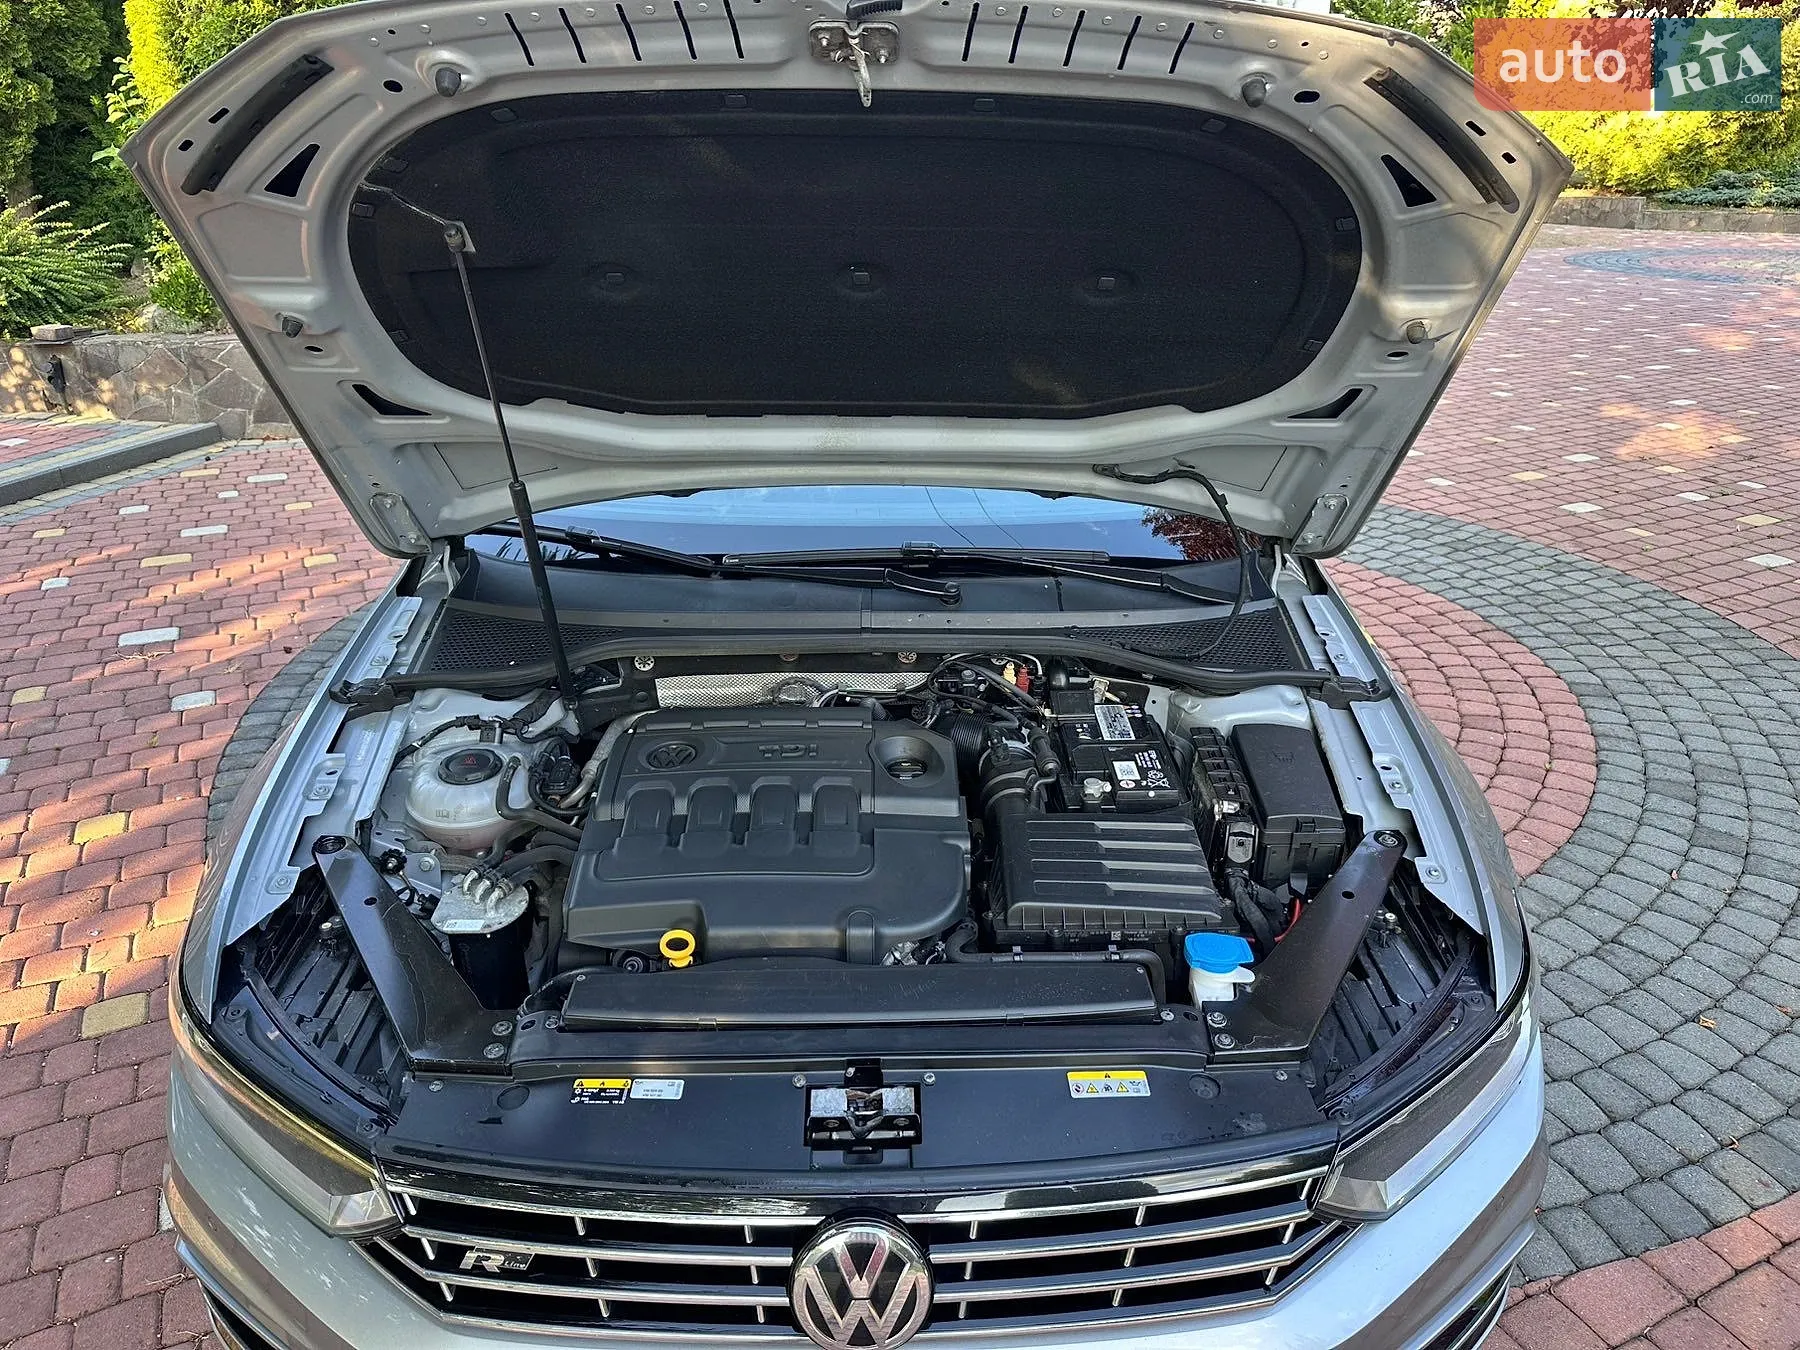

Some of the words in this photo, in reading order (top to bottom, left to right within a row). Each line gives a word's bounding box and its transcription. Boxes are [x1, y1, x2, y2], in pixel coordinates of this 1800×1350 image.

[758, 743, 817, 758] TDI
[459, 1250, 501, 1273] R
[796, 1225, 929, 1349] VW
